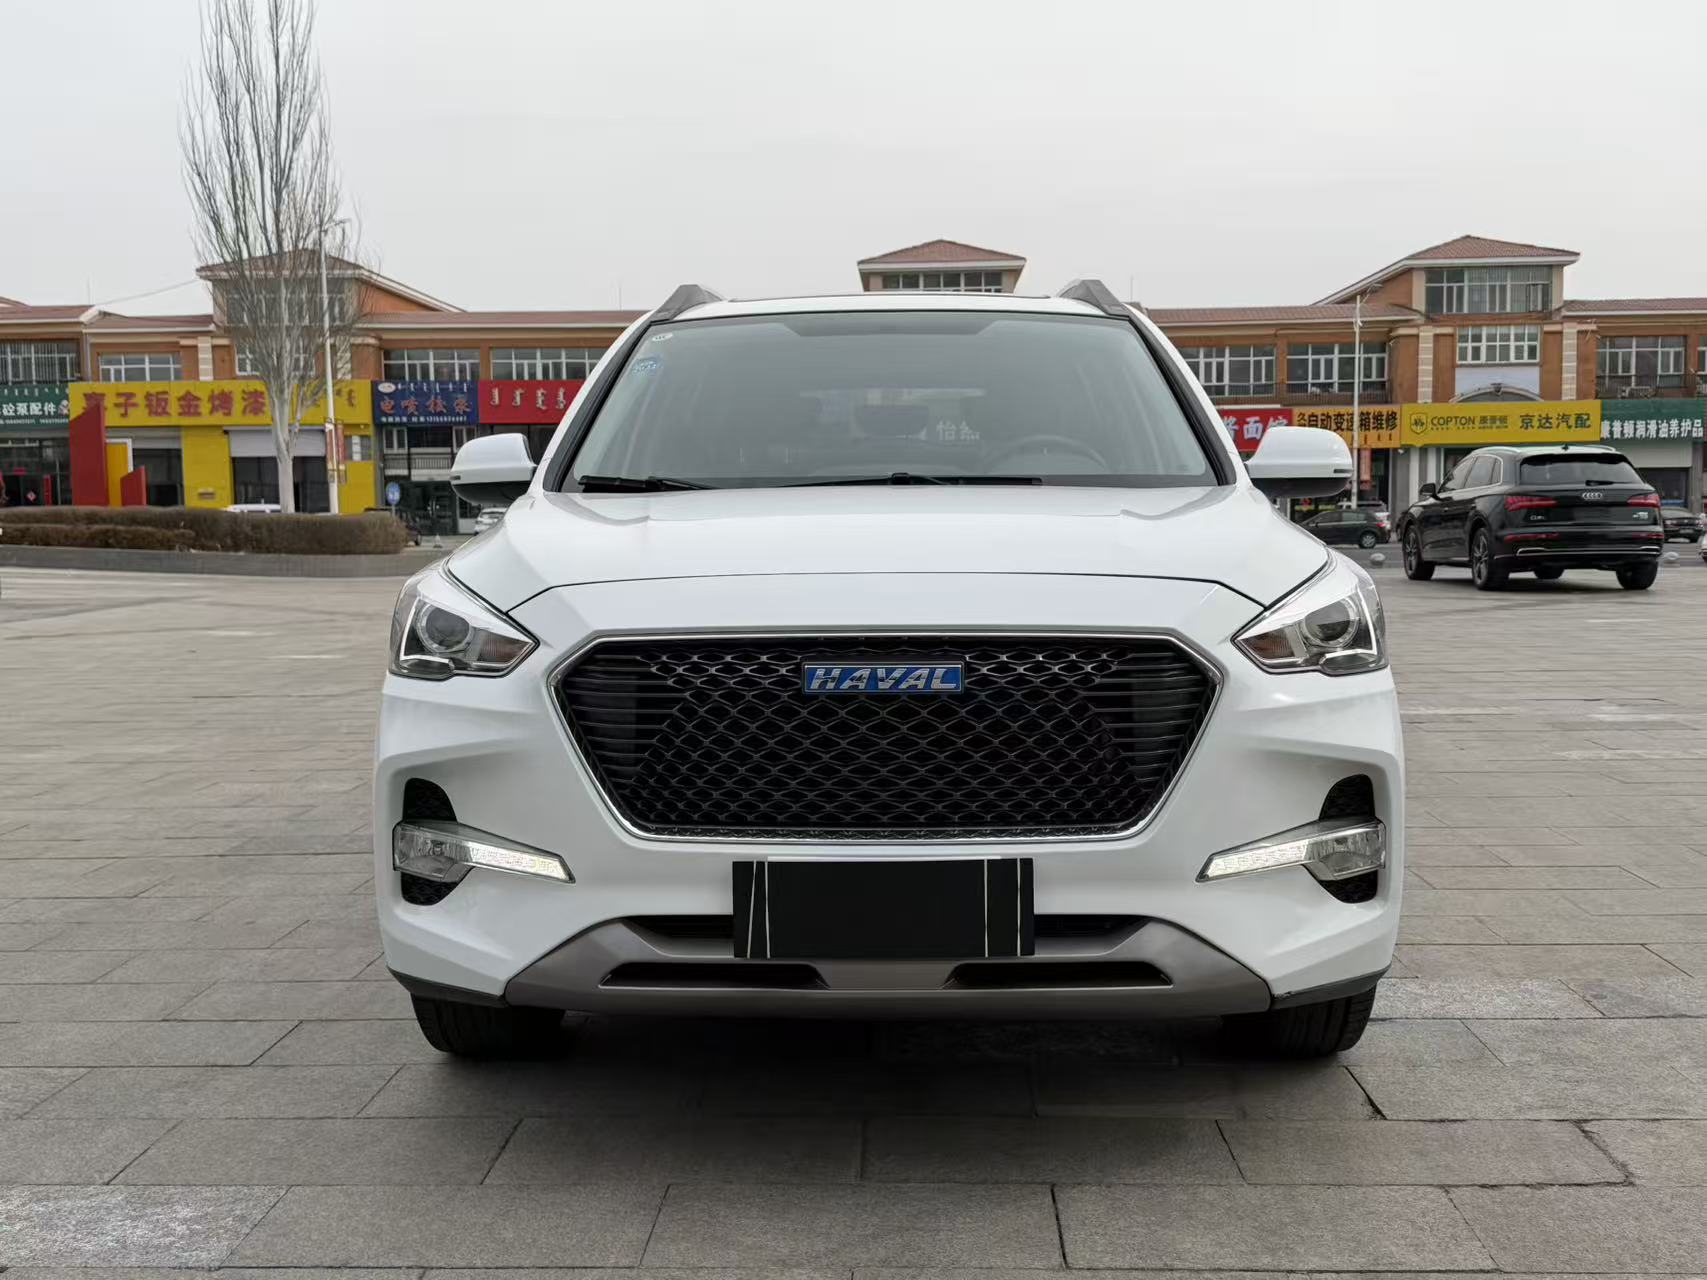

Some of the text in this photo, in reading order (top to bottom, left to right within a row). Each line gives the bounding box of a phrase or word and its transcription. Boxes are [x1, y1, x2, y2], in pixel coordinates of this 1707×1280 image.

[1431, 415, 1476, 427] COPTON
[1519, 412, 1592, 430] 京达汽配
[1601, 420, 1703, 439] 康普顿润滑油养护品
[810, 668, 957, 689] HAVAL
